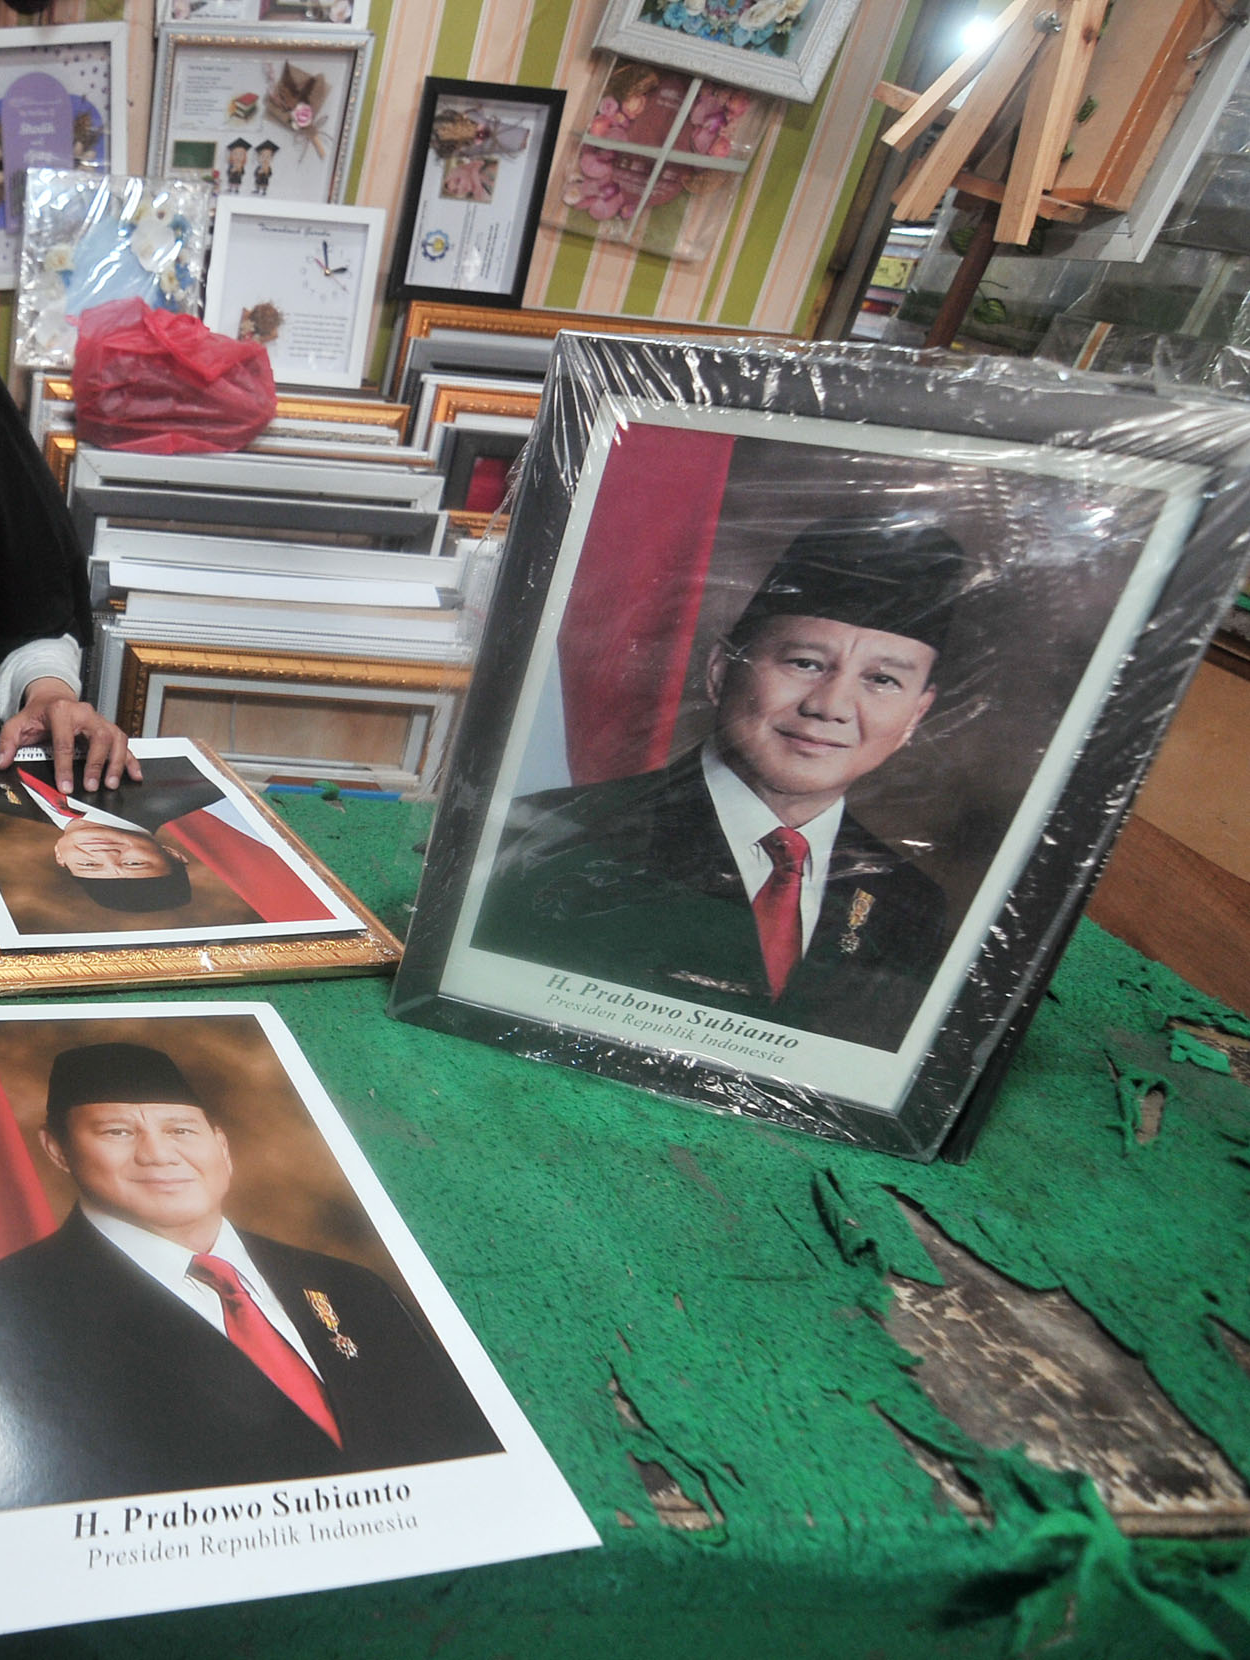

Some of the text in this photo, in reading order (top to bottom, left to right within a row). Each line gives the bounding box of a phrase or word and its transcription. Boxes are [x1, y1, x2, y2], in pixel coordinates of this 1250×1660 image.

[545, 974, 799, 1049] H. Prabowo Subianto
[546, 993, 786, 1064] Presiden Republik Indonesia
[73, 1482, 411, 1541] H. Prabowo Subianto
[87, 1512, 419, 1570] Presiden Republik Indonesia
